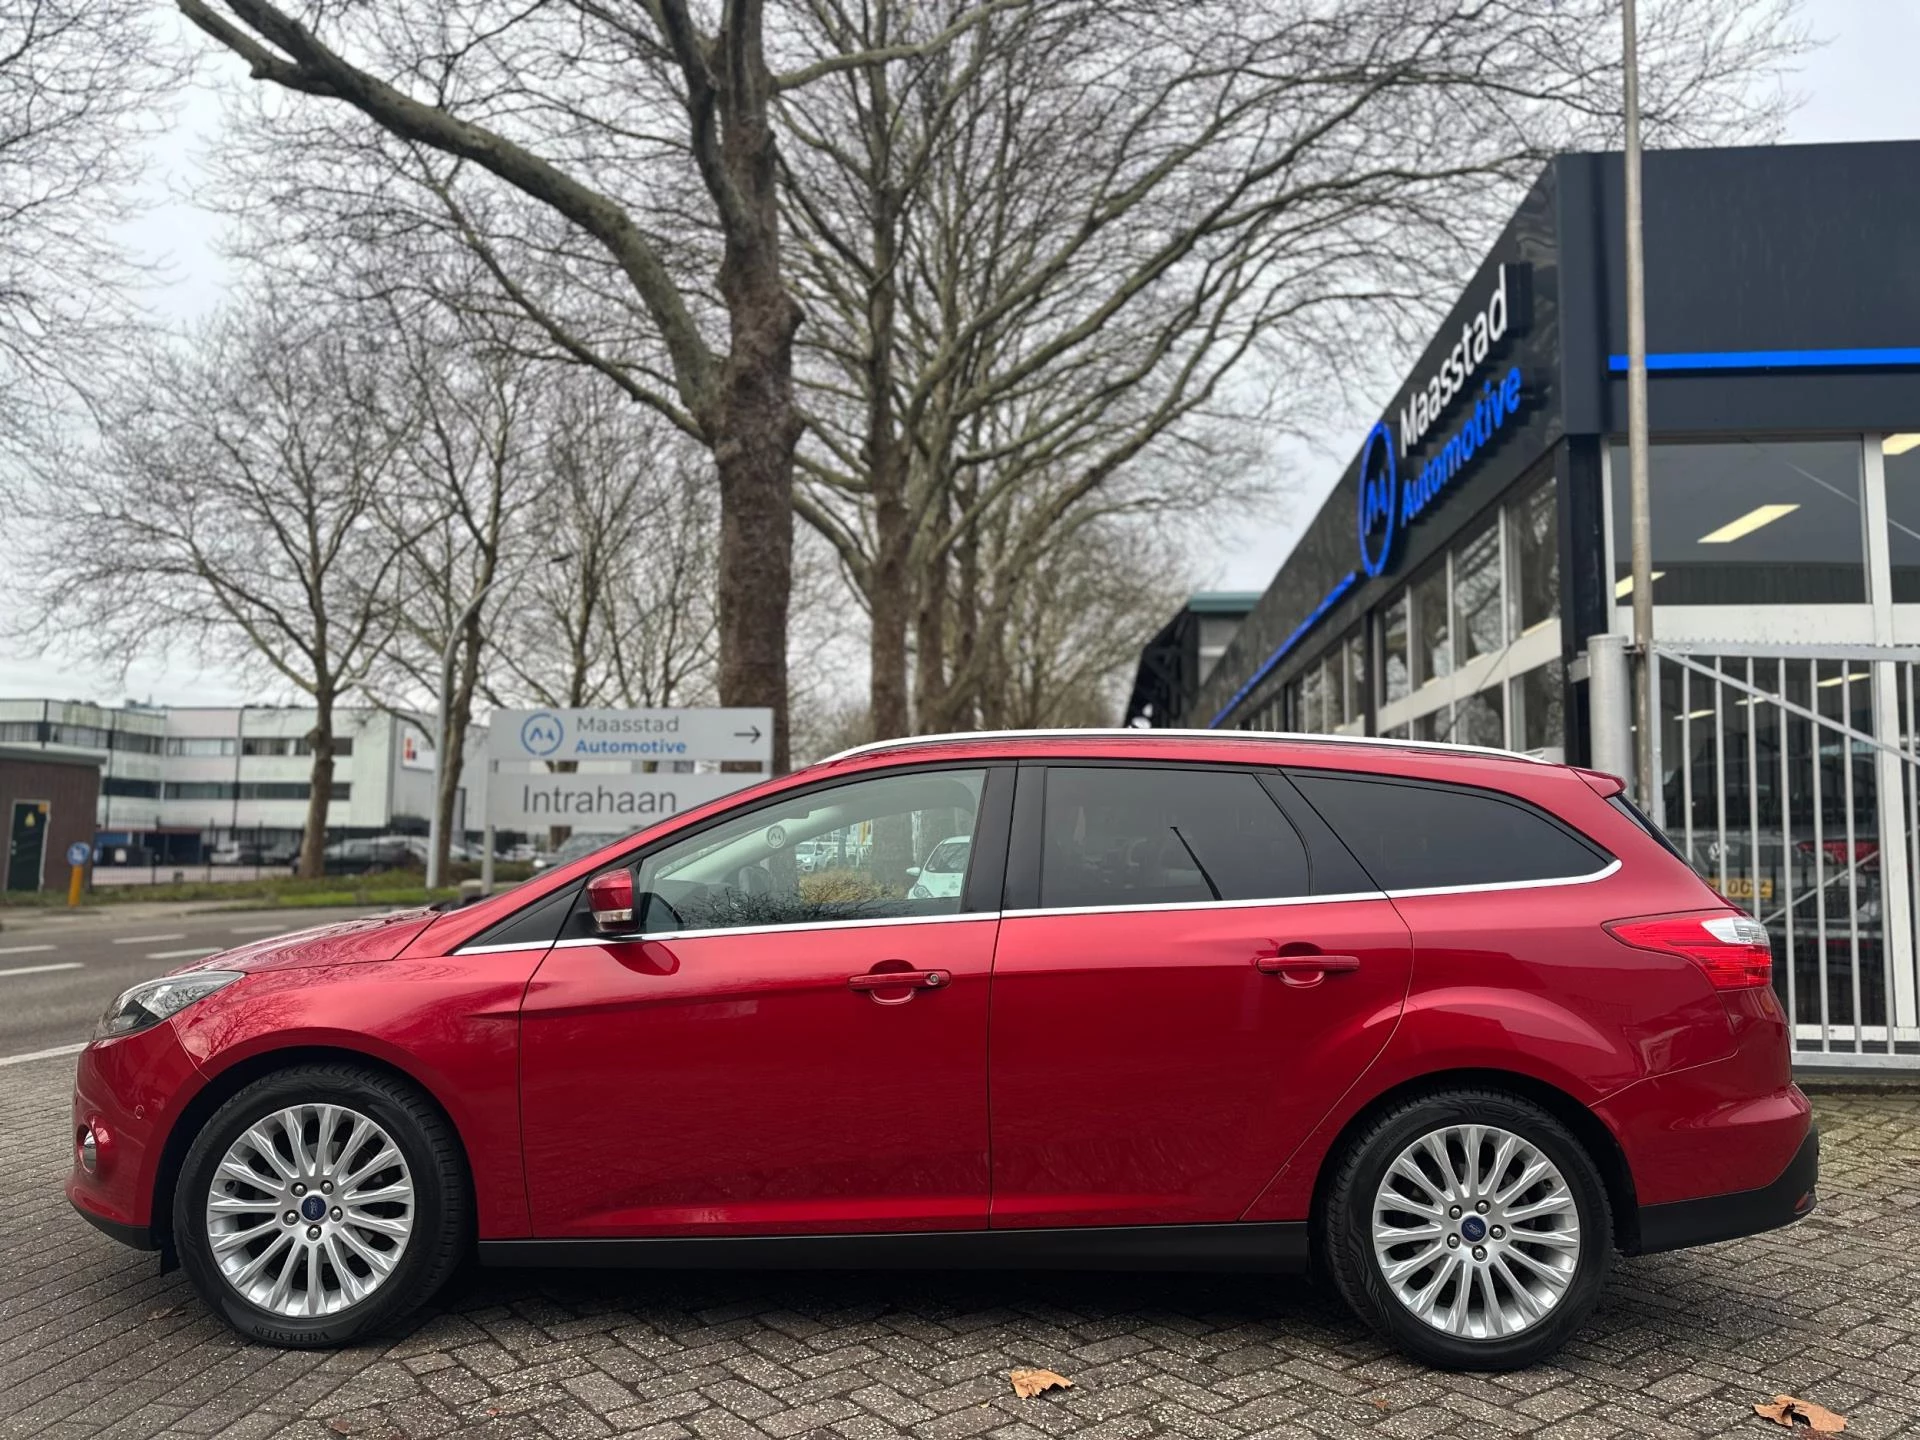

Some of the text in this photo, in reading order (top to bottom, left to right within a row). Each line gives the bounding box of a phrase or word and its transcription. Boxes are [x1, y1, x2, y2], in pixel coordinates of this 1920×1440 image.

[1401, 263, 1508, 458] Maasstad
[1401, 367, 1521, 528] Automotive
[575, 716, 679, 733] Maasstad
[575, 739, 687, 755] Automotive
[523, 785, 677, 814] Intrahaan
[252, 1325, 331, 1342] VREDESTEIN
